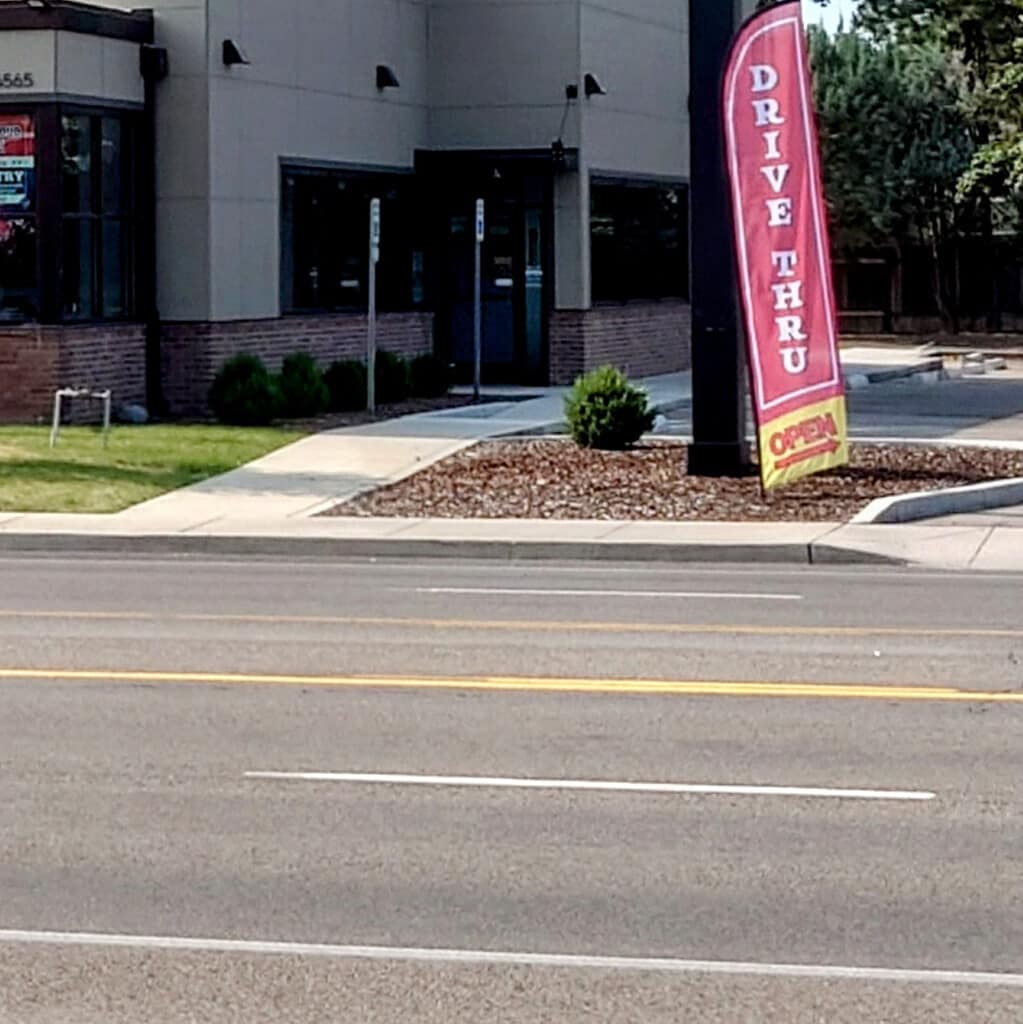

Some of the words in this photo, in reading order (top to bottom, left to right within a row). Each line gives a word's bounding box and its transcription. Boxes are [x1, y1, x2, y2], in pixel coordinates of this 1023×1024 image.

[749, 64, 792, 227] DRIVE
[772, 250, 808, 374] THRU
[769, 412, 837, 456] OPEN
